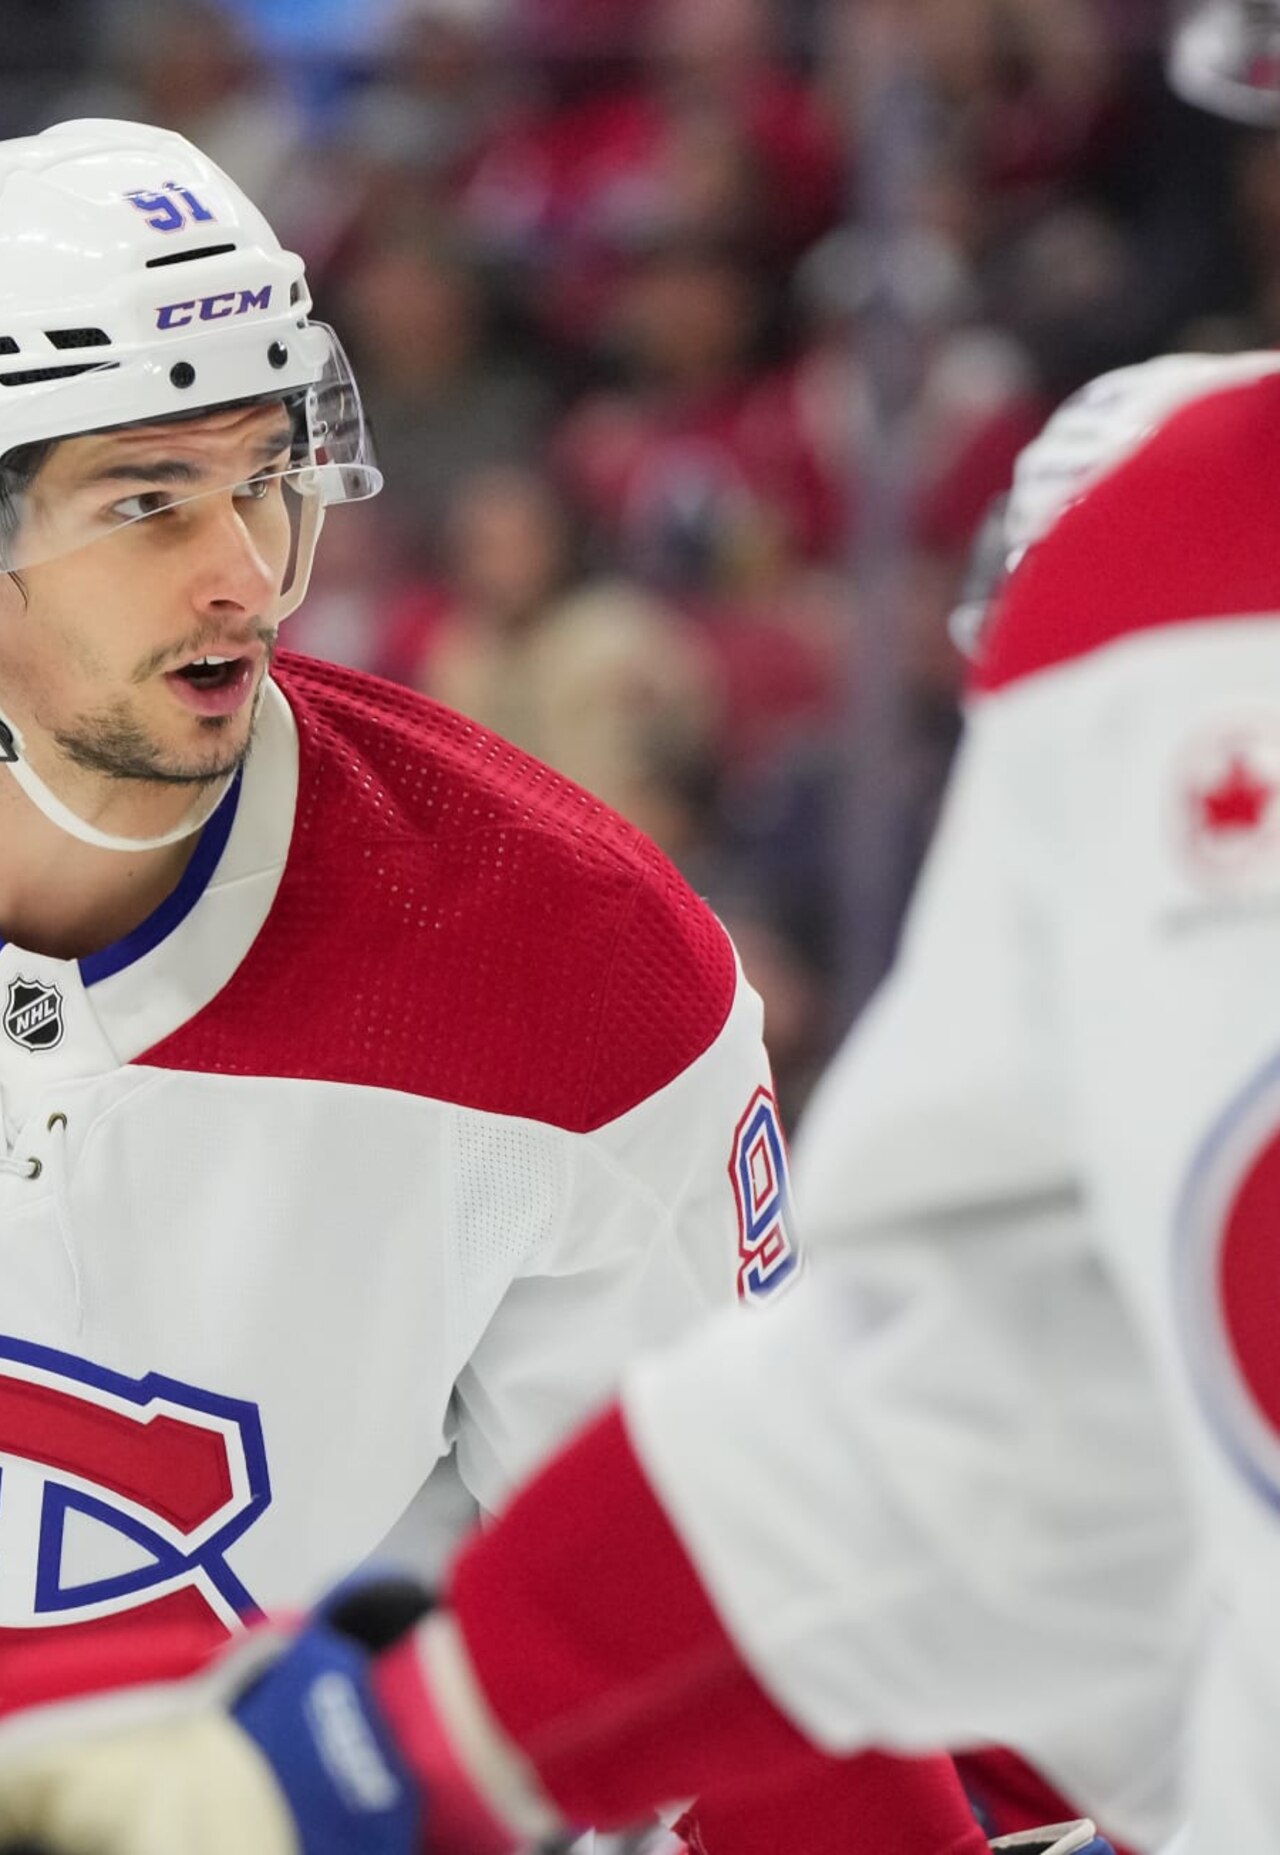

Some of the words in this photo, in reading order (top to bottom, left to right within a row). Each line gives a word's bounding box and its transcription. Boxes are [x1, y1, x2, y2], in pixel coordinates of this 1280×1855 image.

[124, 180, 217, 233] 91
[155, 286, 271, 331] CCM
[16, 999, 55, 1034] NHL
